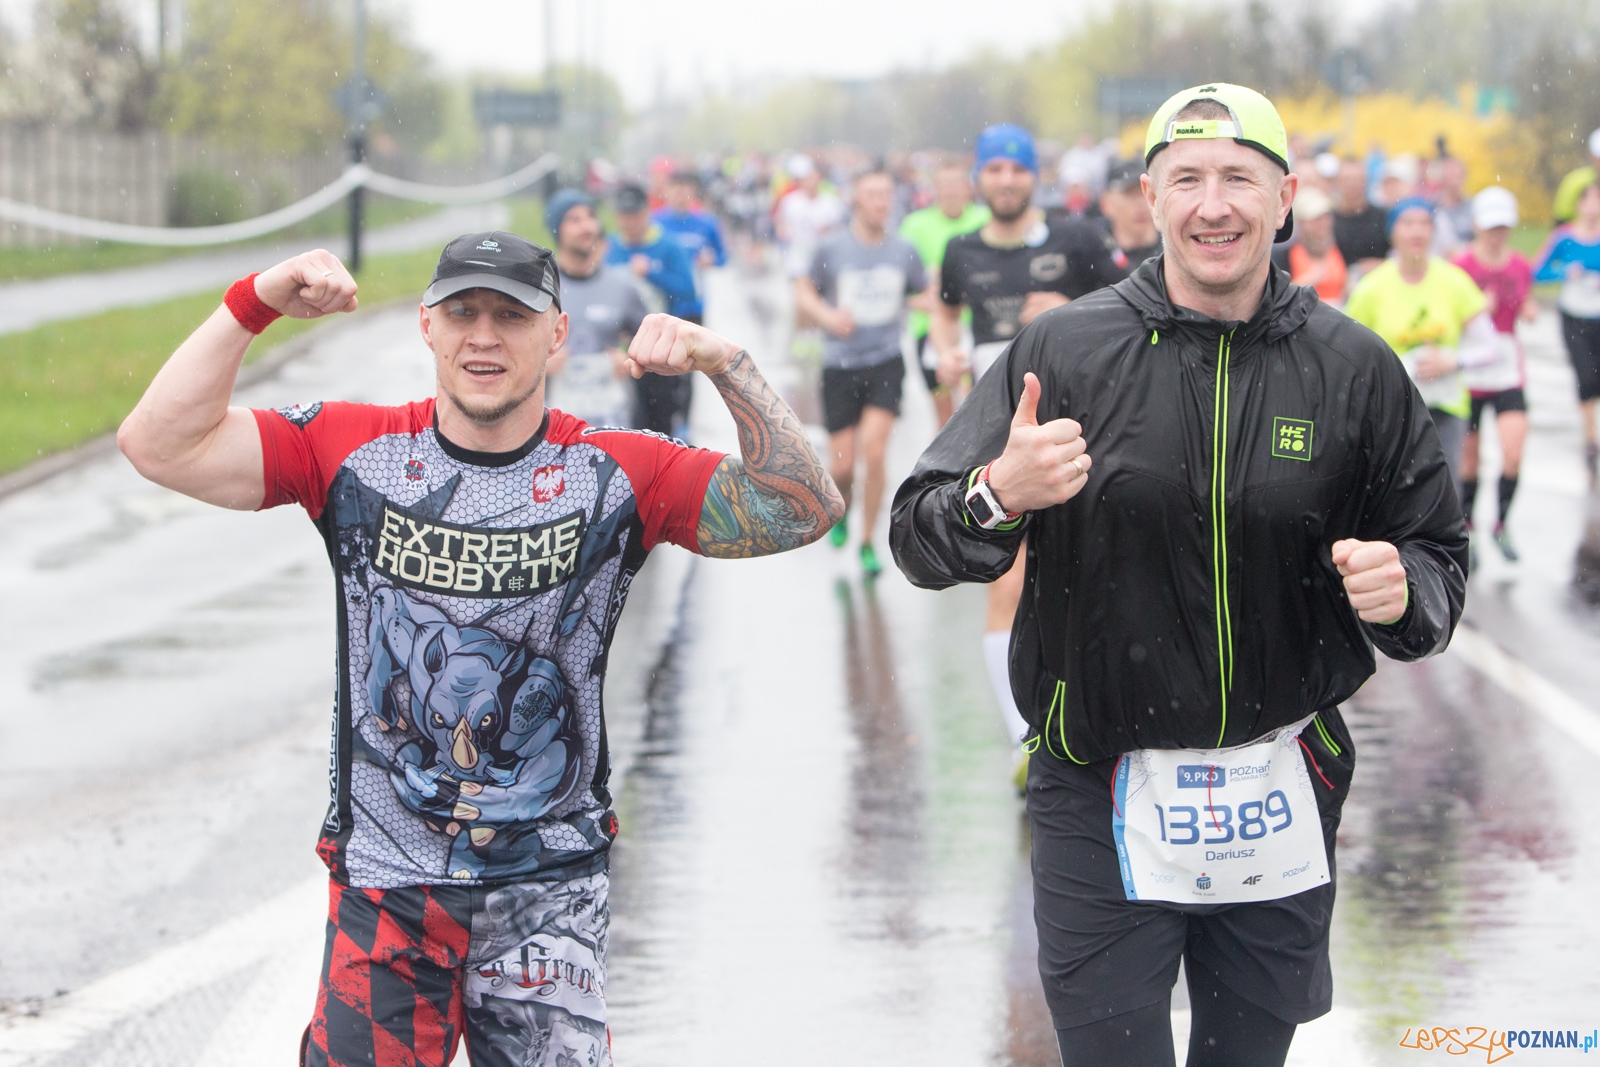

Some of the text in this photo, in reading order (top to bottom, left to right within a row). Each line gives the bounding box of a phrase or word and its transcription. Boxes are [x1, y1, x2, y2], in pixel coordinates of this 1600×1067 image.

[380, 506, 580, 563] EXTREME
[375, 537, 512, 592] HOBBY
[1194, 771, 1219, 782] PKO
[1154, 789, 1293, 845] 13389
[1205, 848, 1256, 862] Dariusz
[1242, 874, 1264, 886] 4F
